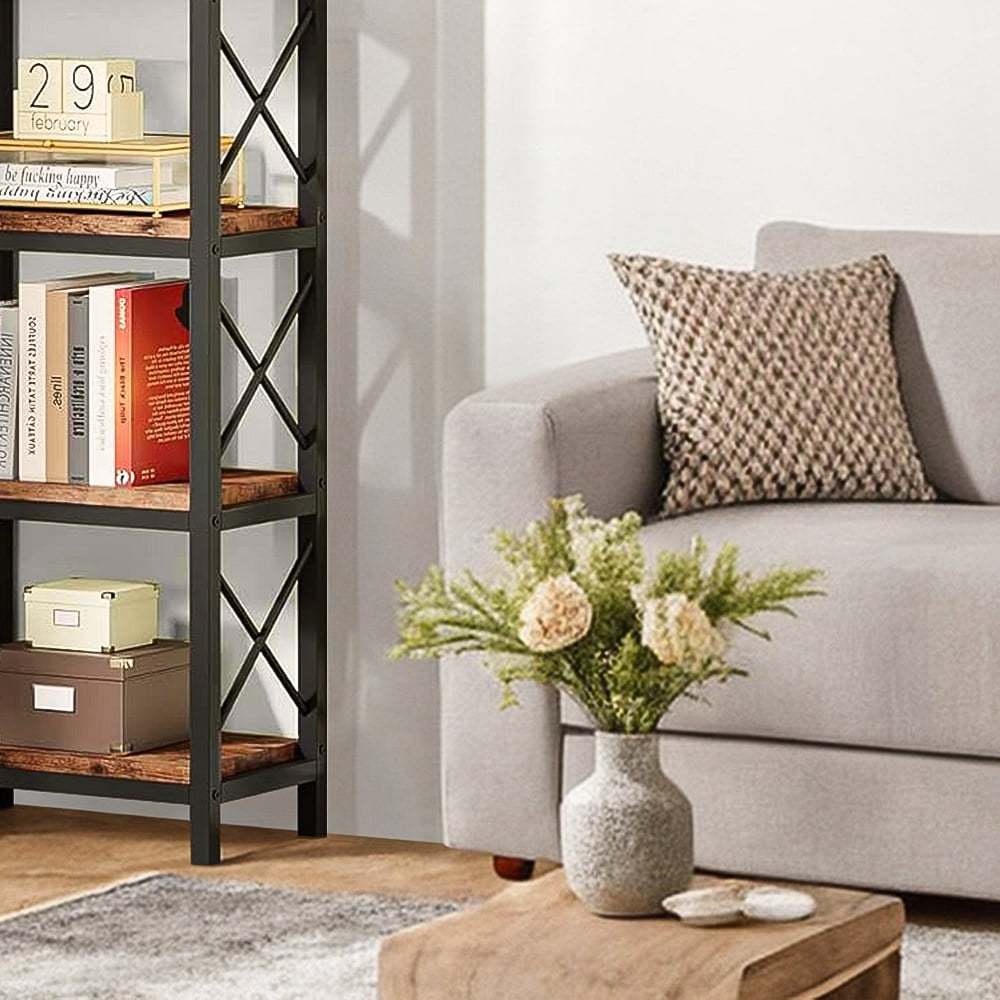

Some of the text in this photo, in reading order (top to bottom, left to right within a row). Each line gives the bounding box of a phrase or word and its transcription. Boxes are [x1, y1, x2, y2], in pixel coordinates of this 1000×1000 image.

[31, 112, 90, 136] february
[4, 164, 100, 189] be fucking happy
